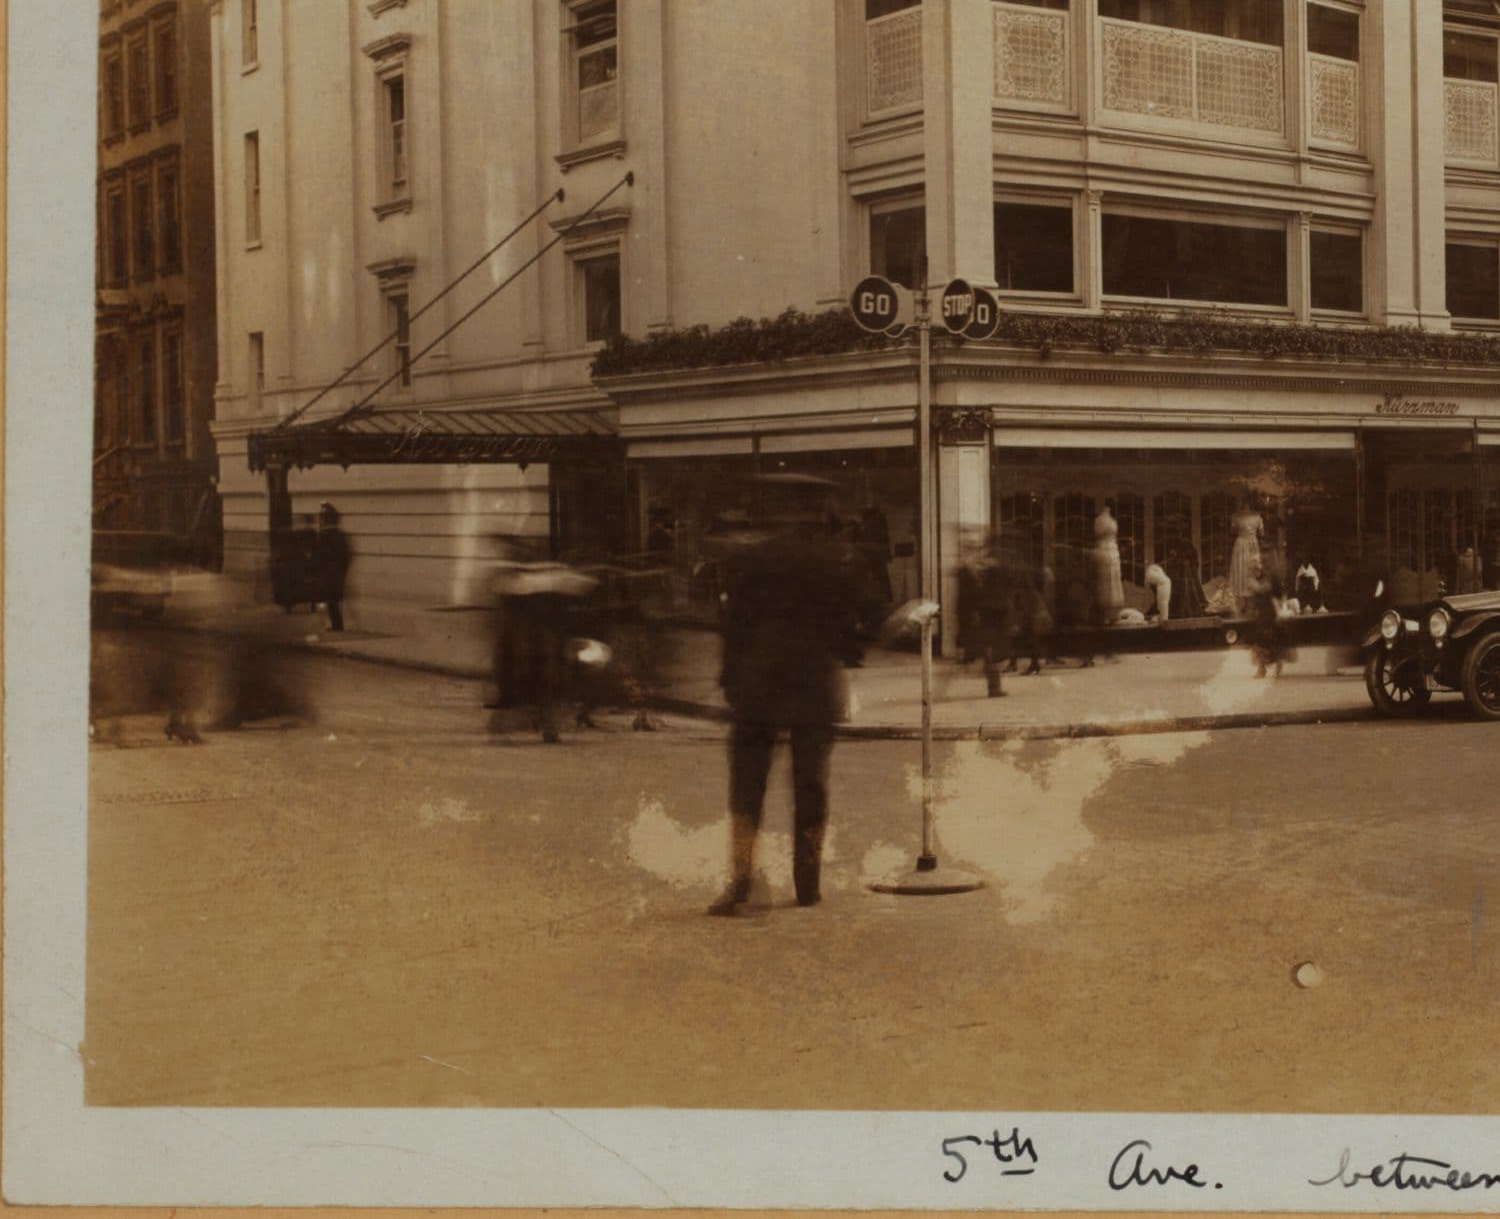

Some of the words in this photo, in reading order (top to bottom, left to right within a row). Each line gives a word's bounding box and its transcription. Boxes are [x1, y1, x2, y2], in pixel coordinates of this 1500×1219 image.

[860, 292, 891, 316] GO
[944, 293, 972, 318] STOP
[942, 1127, 1038, 1182] 5th
